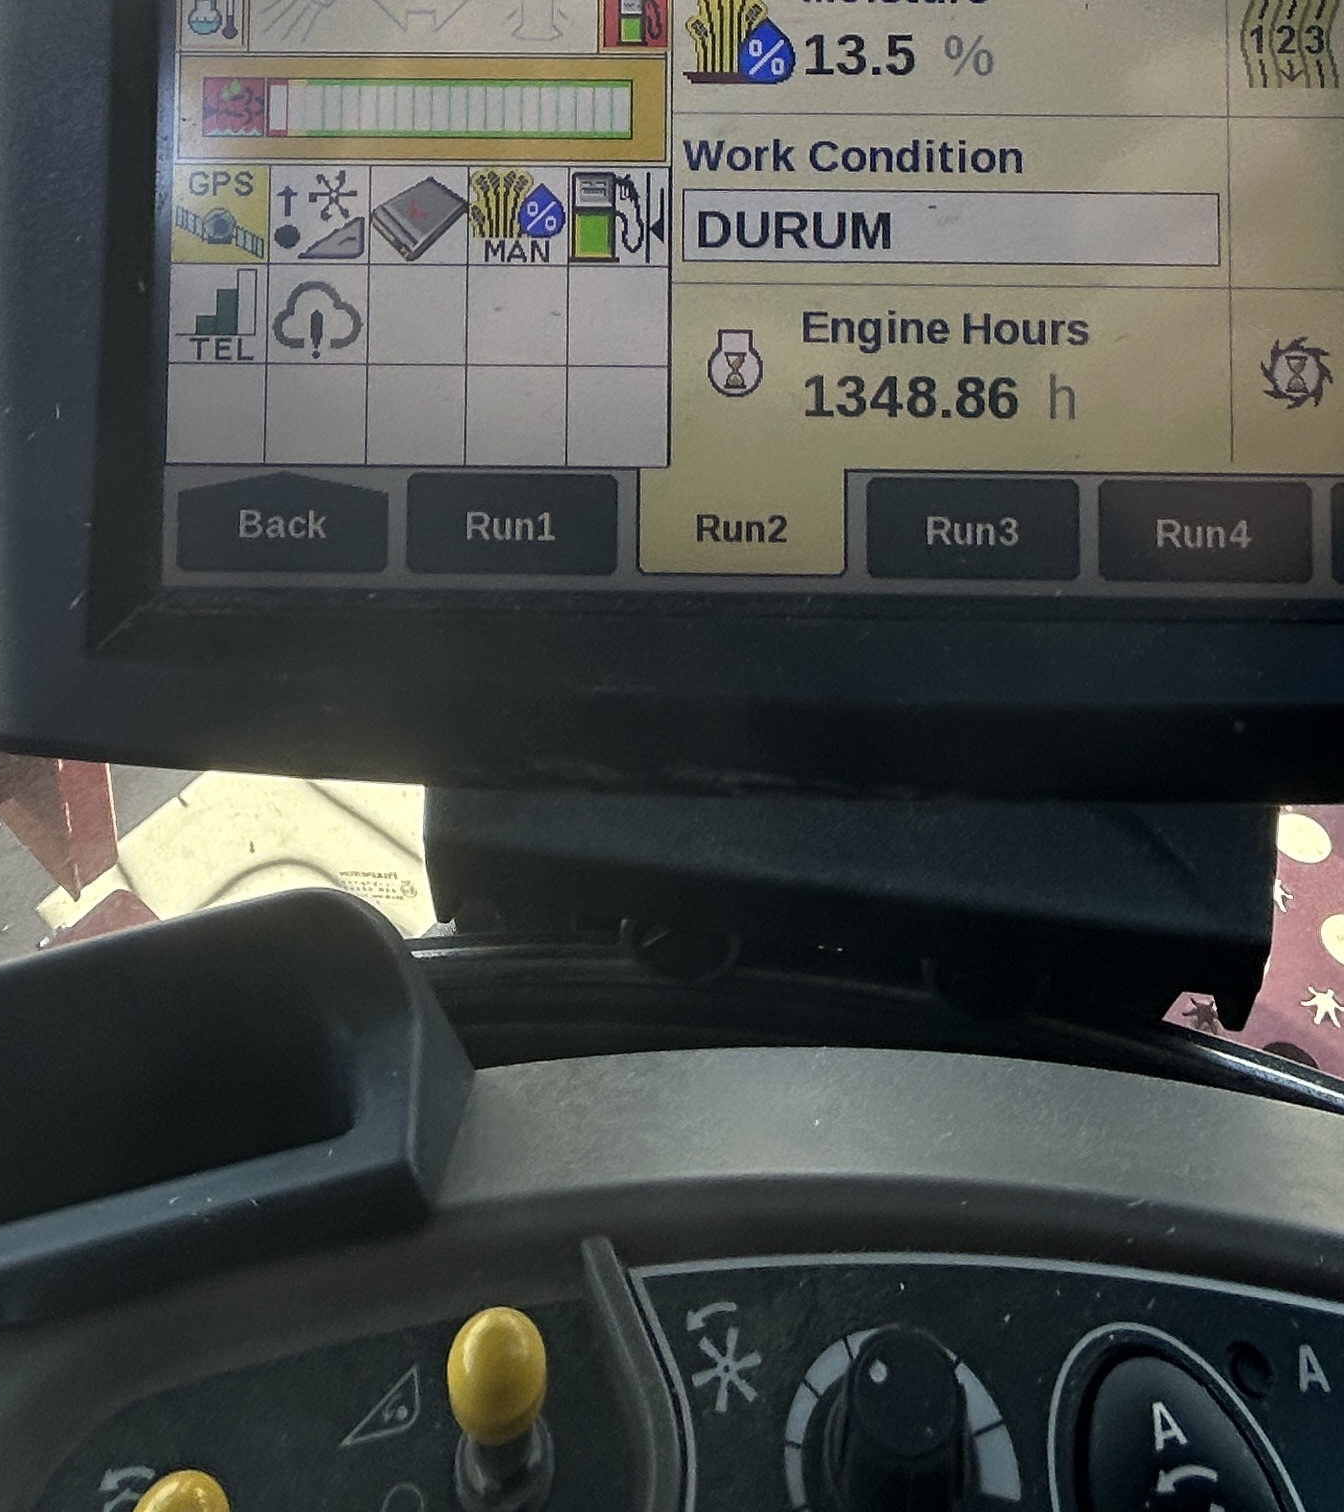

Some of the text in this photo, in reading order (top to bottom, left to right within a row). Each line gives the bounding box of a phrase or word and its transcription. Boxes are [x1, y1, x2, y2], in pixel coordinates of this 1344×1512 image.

[804, 33, 995, 77] 13.5 %
[683, 140, 1024, 174] Work Condition
[187, 171, 255, 196] GPS
[697, 211, 893, 250] DURUM
[484, 240, 551, 263] MAN
[801, 310, 1089, 353] Engine Hours
[189, 337, 254, 361] TEL
[804, 373, 1077, 419] 1348.86 h
[238, 509, 328, 539] Back
[466, 512, 555, 541] Run1
[696, 514, 788, 543] Run2
[926, 516, 1020, 546] Run3
[1156, 519, 1252, 549] Run4
[1299, 1344, 1331, 1393] A
[1152, 1402, 1188, 1452] A
